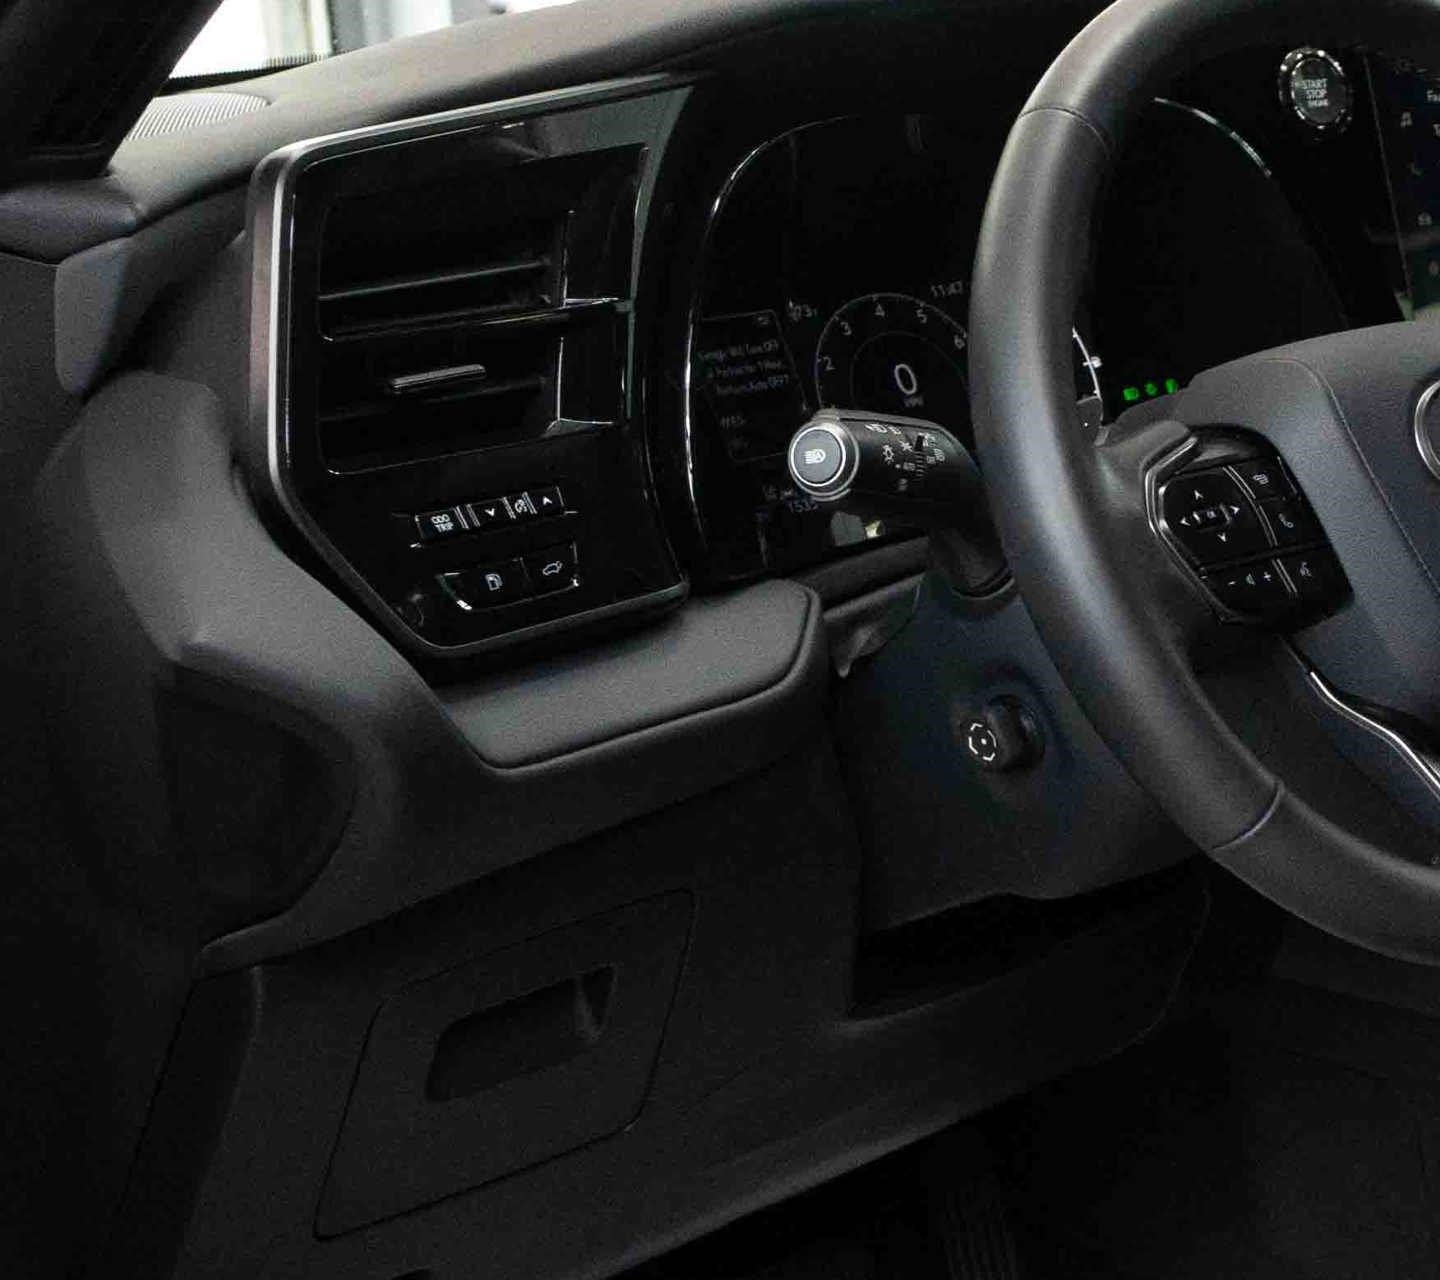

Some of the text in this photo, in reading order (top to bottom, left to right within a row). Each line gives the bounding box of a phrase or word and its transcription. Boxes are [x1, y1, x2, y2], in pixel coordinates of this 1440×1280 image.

[840, 321, 853, 337] 3
[823, 355, 836, 372] 2
[893, 363, 918, 396] 0
